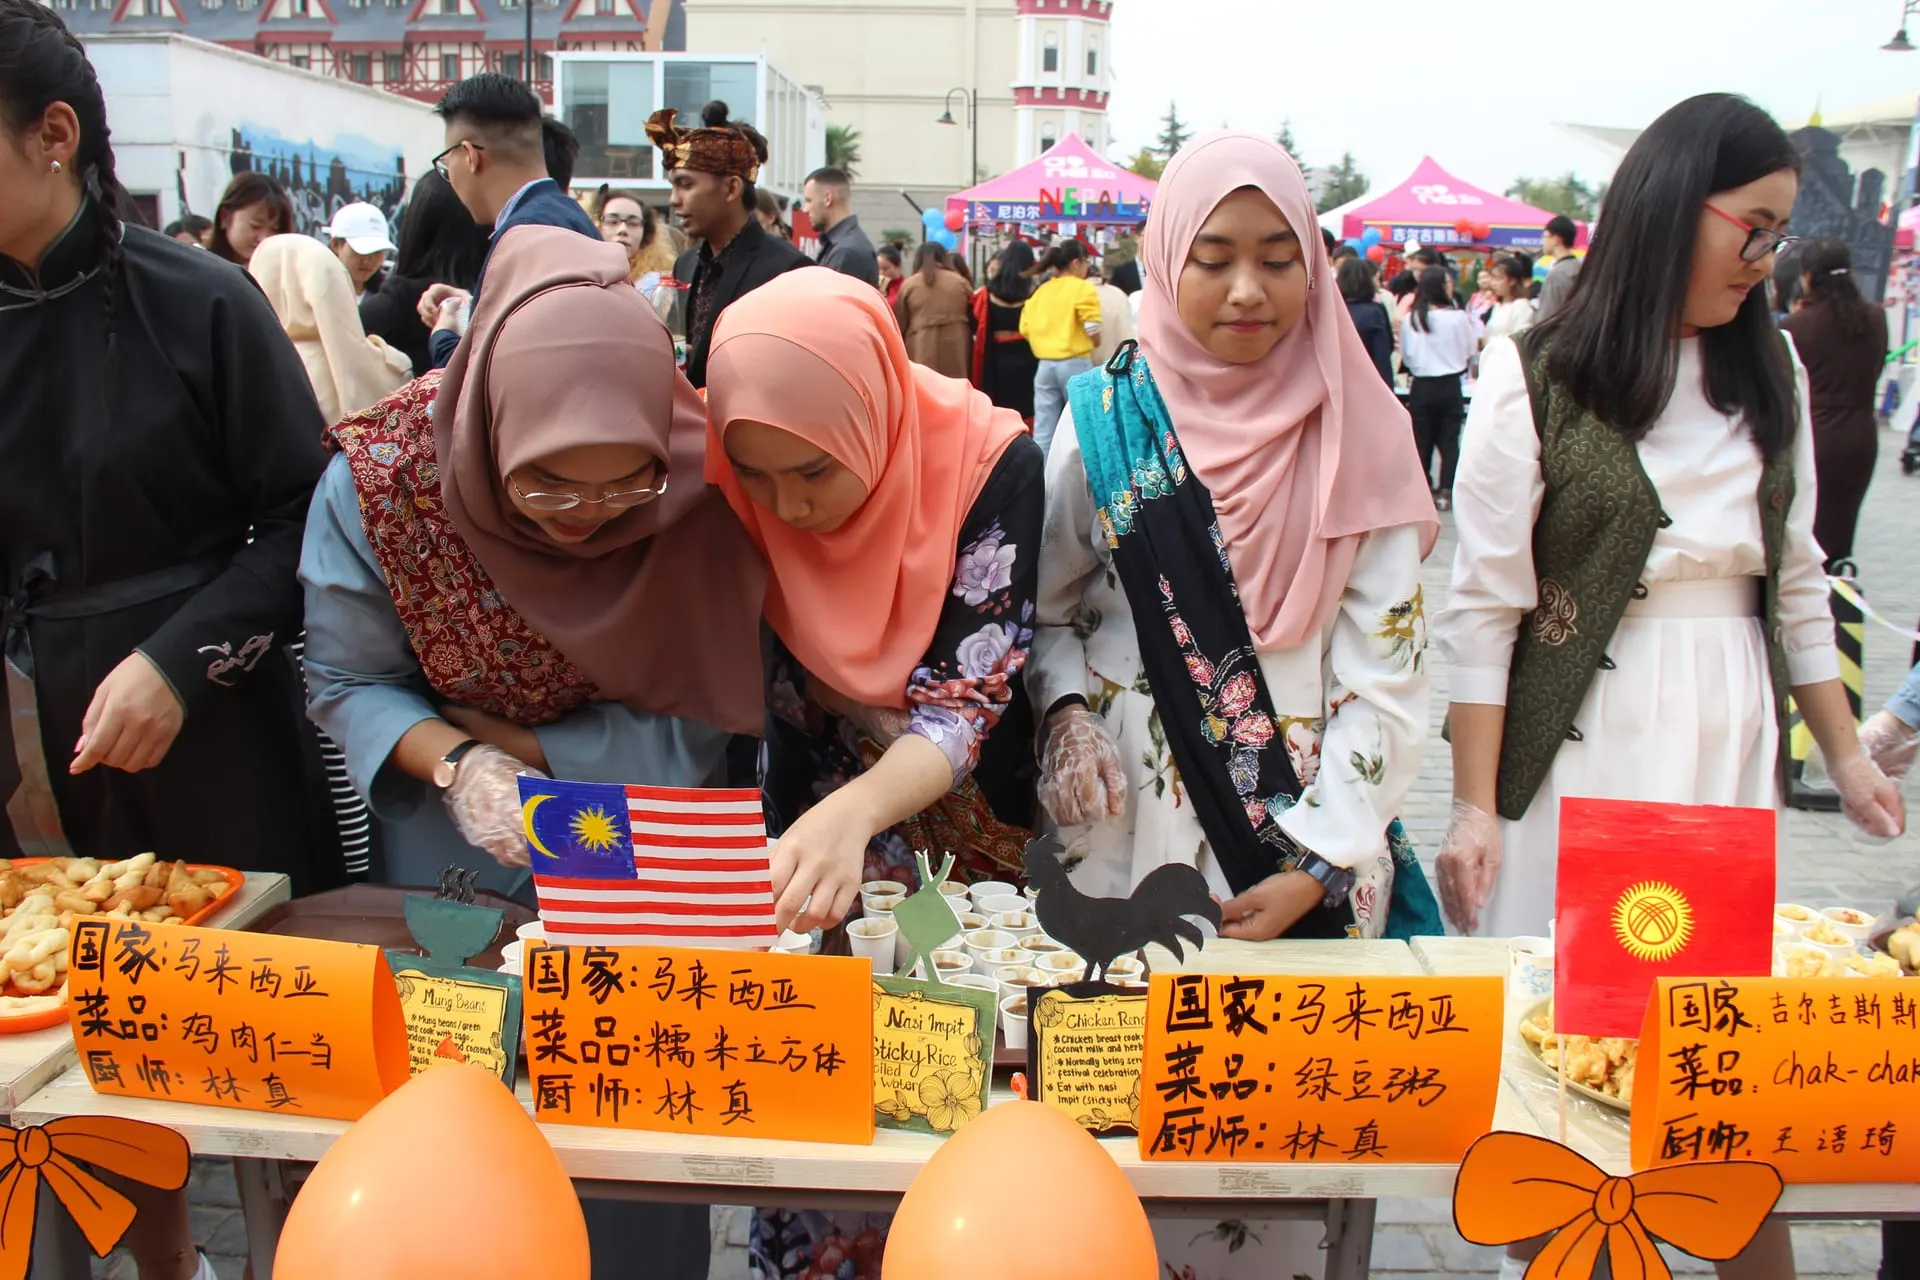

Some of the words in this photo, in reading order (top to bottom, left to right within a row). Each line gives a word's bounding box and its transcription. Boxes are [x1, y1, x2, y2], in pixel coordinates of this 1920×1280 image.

[1039, 187, 1133, 217] NEPAL
[998, 205, 1040, 220] 尼泊尔
[422, 988, 453, 1011] Mung
[418, 1015, 437, 1027] Mung
[884, 1007, 923, 1030] Nasi
[928, 1013, 965, 1041] Impit
[1066, 1013, 1115, 1029] Chicken
[1061, 1035, 1094, 1044] Chicken
[1096, 1033, 1121, 1044] breast
[1123, 1033, 1140, 1042] cook
[926, 1043, 957, 1067] Rice
[1054, 1045, 1083, 1054] coconut
[1107, 1045, 1121, 1053] and
[1103, 1056, 1124, 1066] being
[874, 1063, 901, 1077] oiled
[1058, 1068, 1090, 1080] festival
[1057, 1082, 1072, 1092] Eat
[1075, 1082, 1095, 1092] with
[1098, 1081, 1117, 1092] nasi
[1058, 1095, 1080, 1106] Impit
